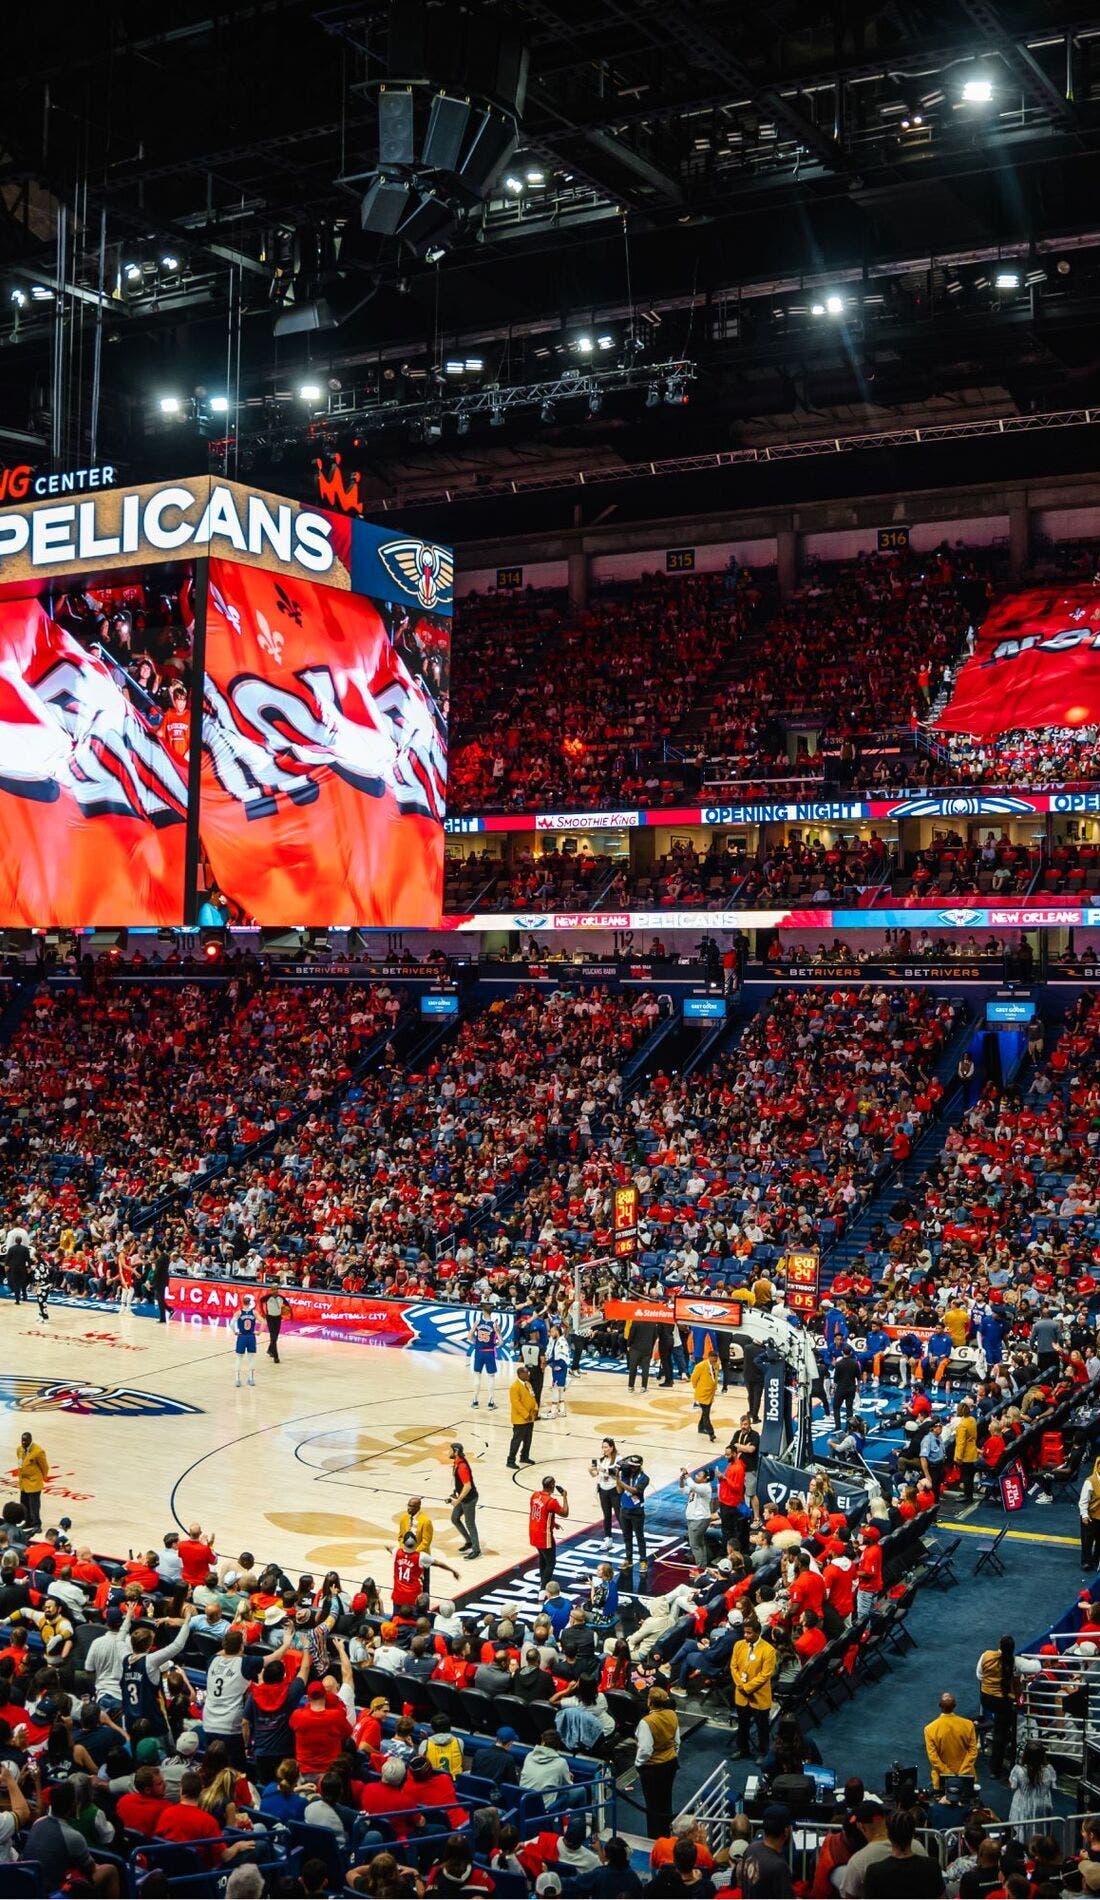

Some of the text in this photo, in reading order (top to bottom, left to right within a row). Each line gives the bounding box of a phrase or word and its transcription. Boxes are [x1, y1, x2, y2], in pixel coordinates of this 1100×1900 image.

[35, 466, 114, 495] CENTER
[0, 486, 334, 572] PELICANS
[881, 534, 907, 547] 316
[669, 554, 693, 568] 315
[499, 572, 522, 584] 314
[705, 802, 856, 824] OPENING NIGHT
[557, 816, 607, 828] SMOOTHIE
[555, 912, 738, 928] NEW ORLEANS PELICANS
[991, 912, 1019, 924] NEW
[1021, 911, 1080, 923] ORLEANS
[382, 967, 439, 975] BETRIVERS
[790, 968, 861, 977] BETRIVERS
[904, 968, 980, 977] BETRIVERS
[618, 1205, 633, 1228] 24
[313, 1302, 332, 1310] CITY
[766, 1378, 779, 1421] ibotta
[398, 1566, 411, 1583] 14
[127, 1683, 138, 1705] 3
[214, 1677, 224, 1698] 3
